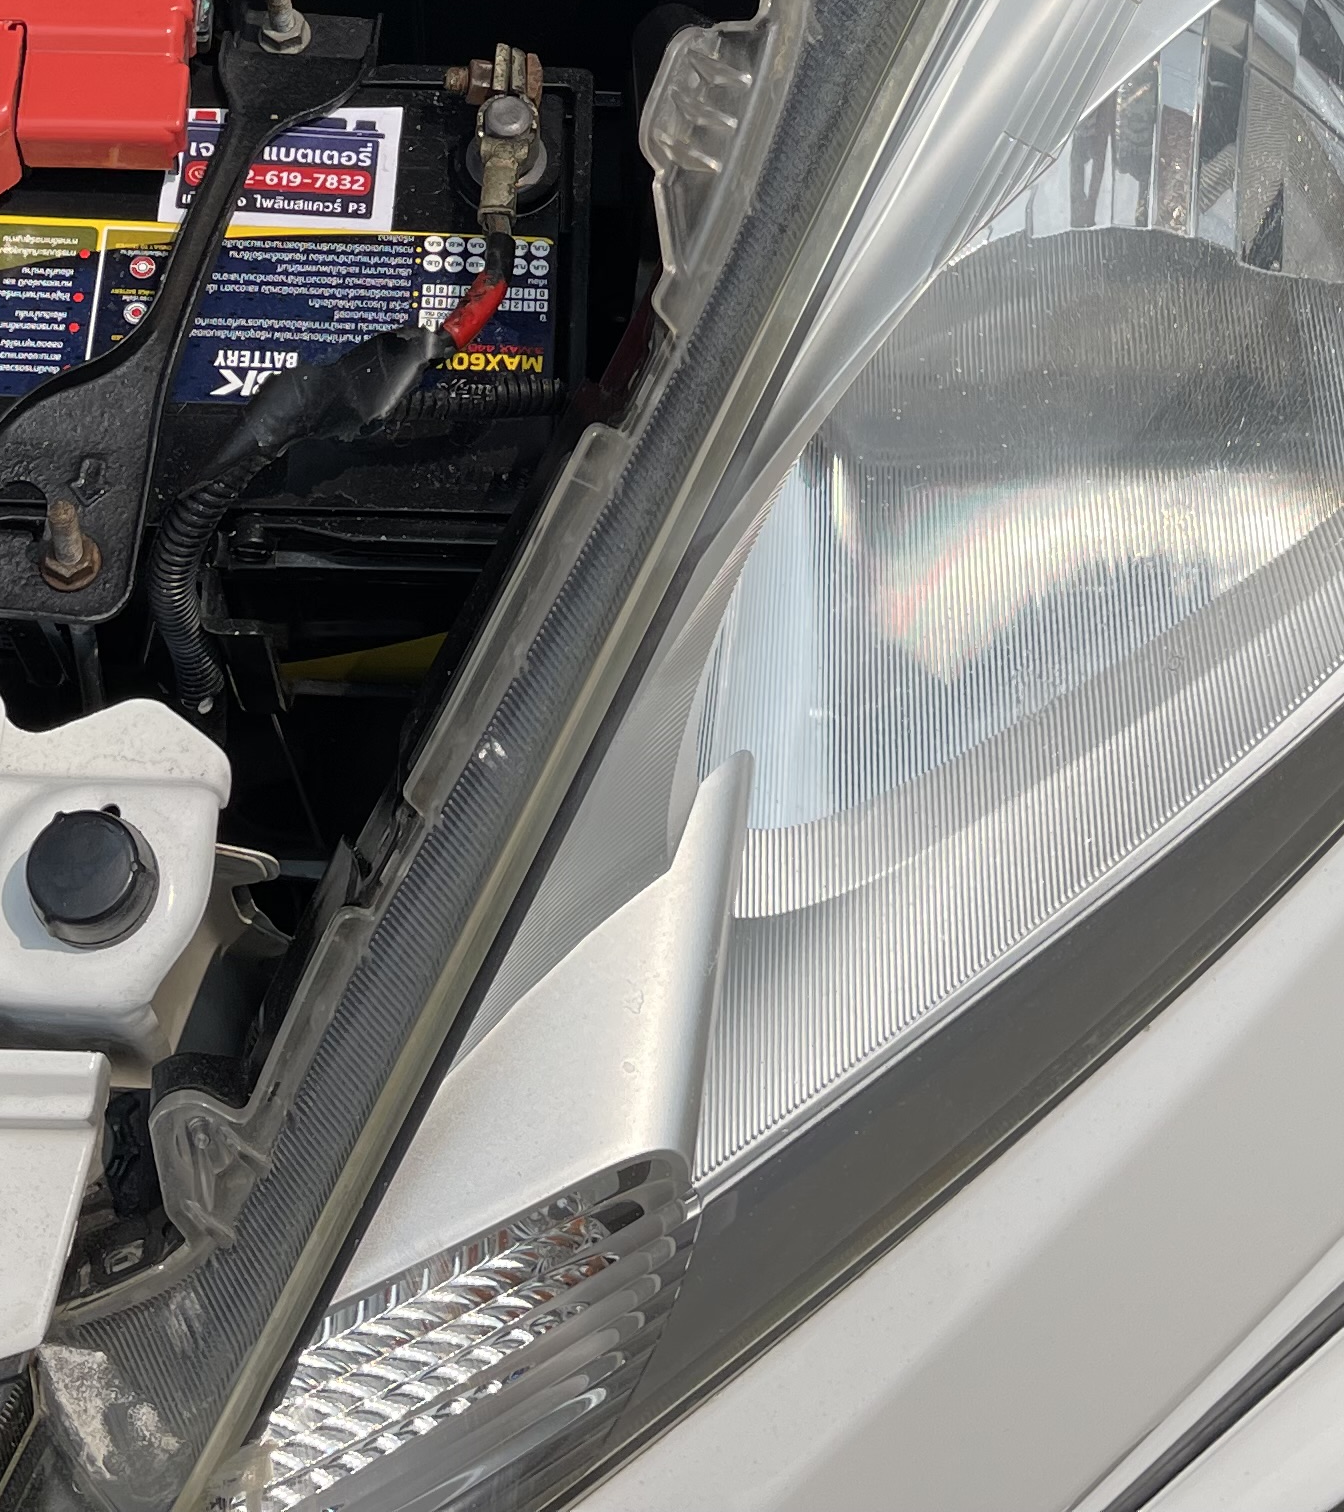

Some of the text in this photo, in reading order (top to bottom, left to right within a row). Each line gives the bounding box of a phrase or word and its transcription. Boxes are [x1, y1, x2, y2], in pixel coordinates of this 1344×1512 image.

[263, 143, 372, 166] แบตเตอรี่
[348, 202, 366, 214] P3
[214, 350, 298, 368] BATTERY
